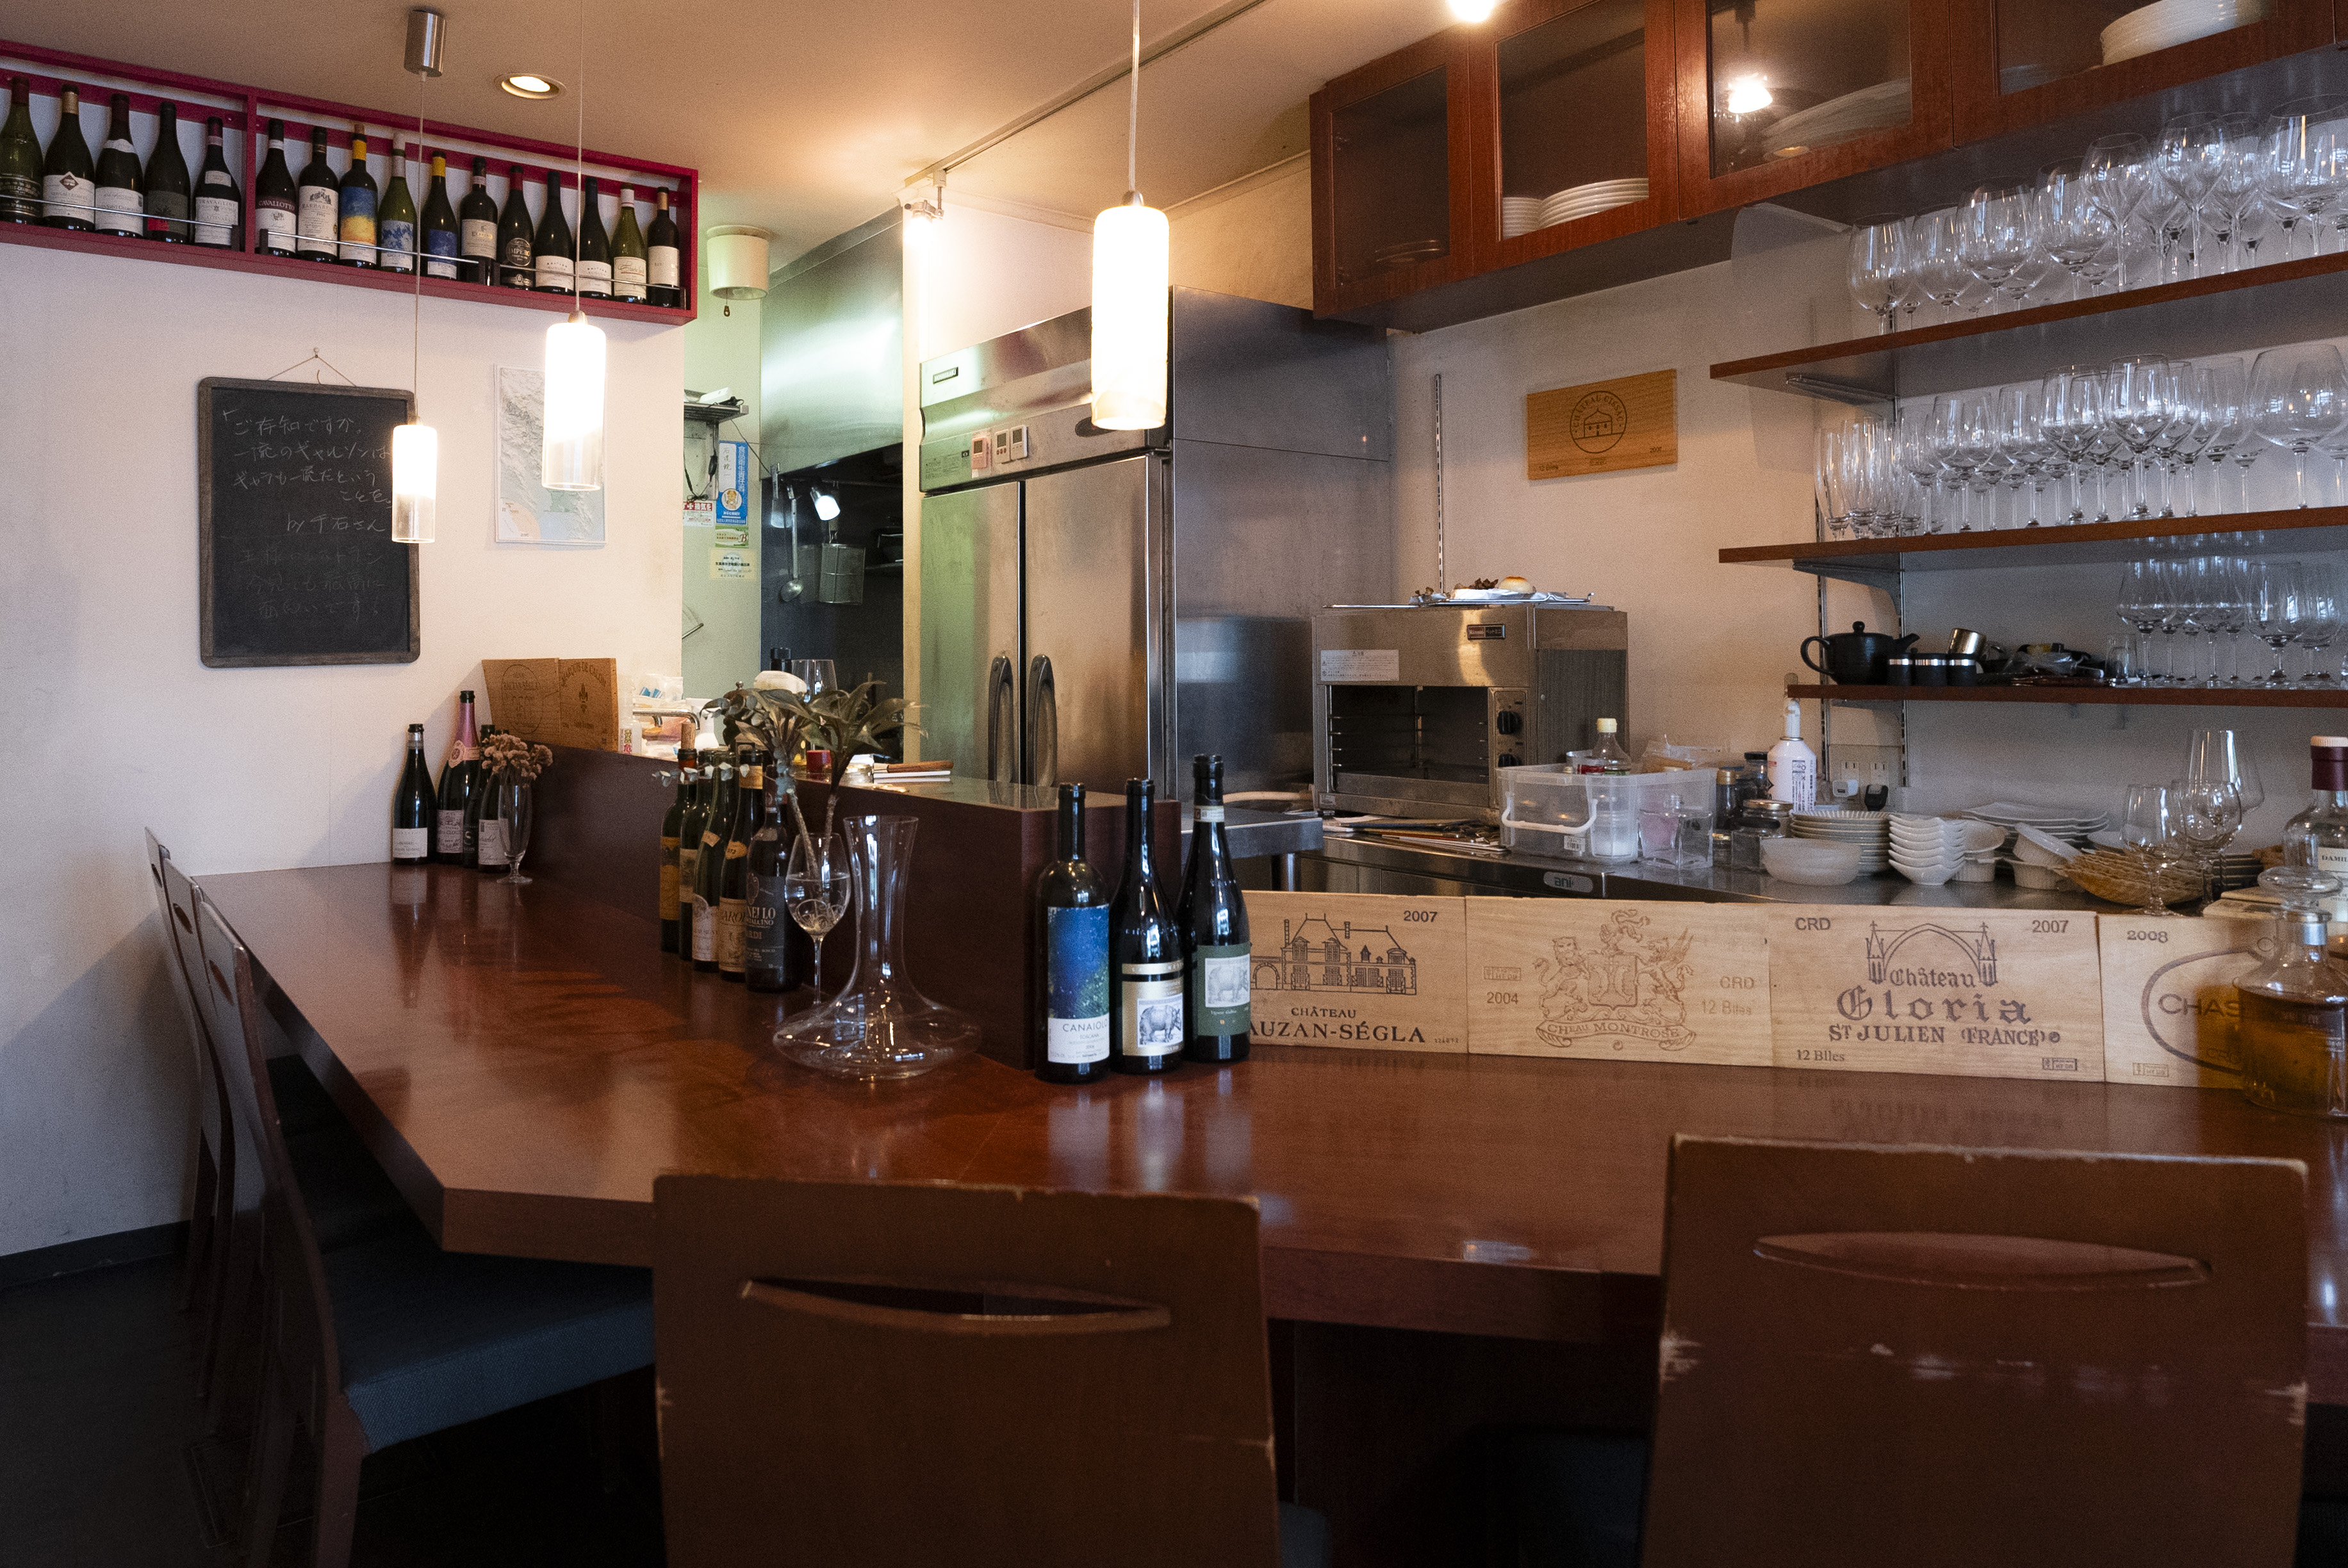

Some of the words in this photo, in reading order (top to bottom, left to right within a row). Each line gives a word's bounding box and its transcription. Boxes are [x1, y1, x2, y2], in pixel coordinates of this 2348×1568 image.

[258, 200, 295, 211] CAVALLOTTO
[934, 368, 957, 383] HOSHIZAKI
[287, 514, 305, 534] by
[1403, 910, 1438, 923] 2007
[1794, 917, 1831, 931] CRD
[2032, 920, 2069, 934] 2007
[2126, 929, 2169, 943] 2008
[1719, 976, 1755, 990] CRD
[1890, 967, 1977, 988] Château
[1486, 992, 1518, 1004] 2004
[1837, 984, 2032, 1024] Gloria
[2158, 993, 2241, 1017] CHAS
[1291, 1007, 1357, 1019] CHÂTEAU
[1062, 1018, 1108, 1032] CANAIOLO
[1250, 1020, 1426, 1043] AUZAN-SÉGLA
[1593, 1022, 1681, 1039] MONTROSE
[1857, 1025, 1945, 1043] JULIEN
[1796, 1050, 1810, 1061] 12
